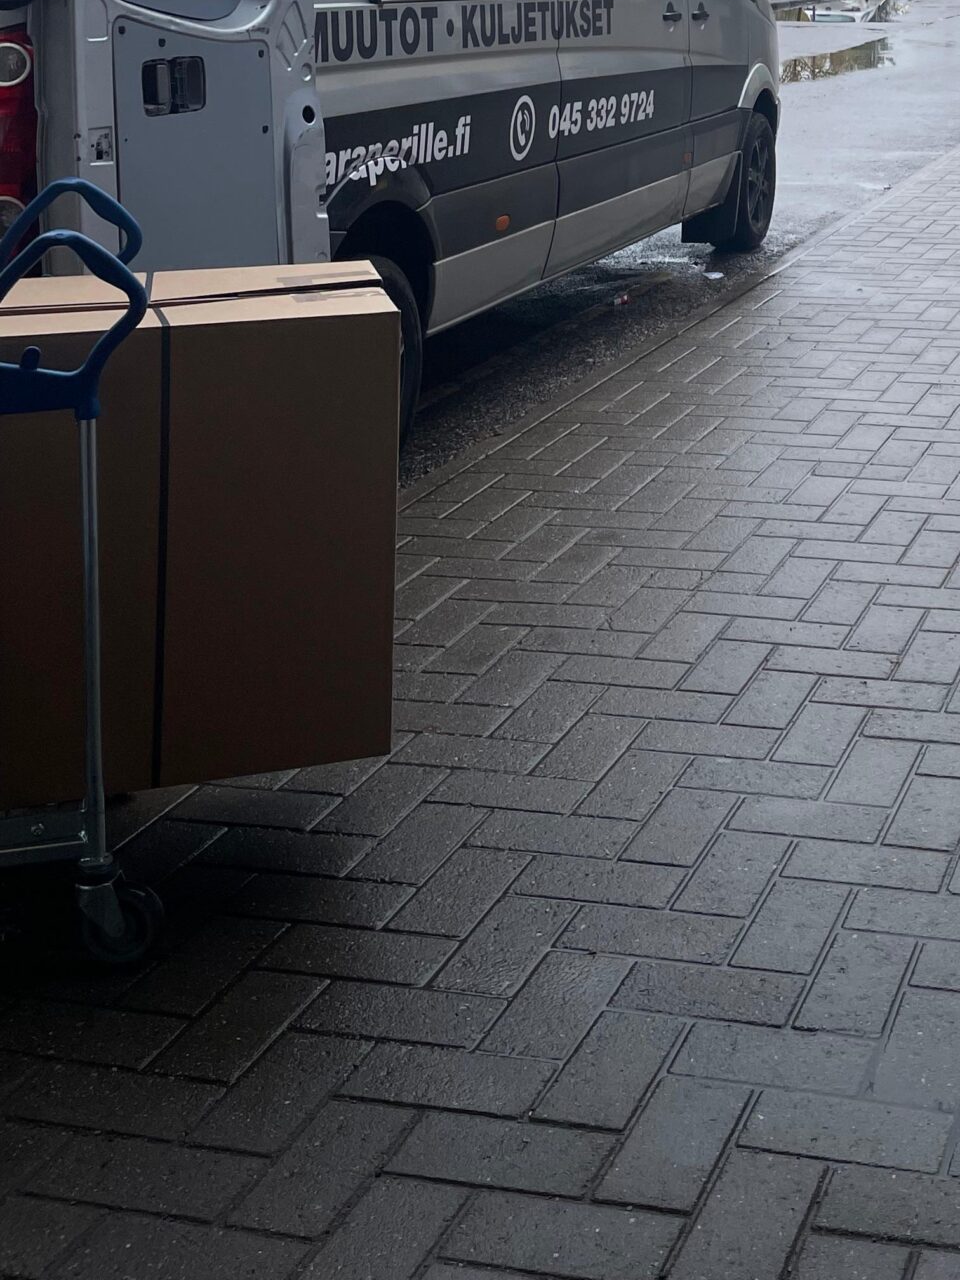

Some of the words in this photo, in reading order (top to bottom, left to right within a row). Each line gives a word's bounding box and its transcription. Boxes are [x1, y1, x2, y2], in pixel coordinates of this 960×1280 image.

[461, 0, 615, 48] KULJETUKSET
[548, 101, 583, 139] 045
[586, 95, 617, 132] 332
[620, 89, 655, 125] 9724
